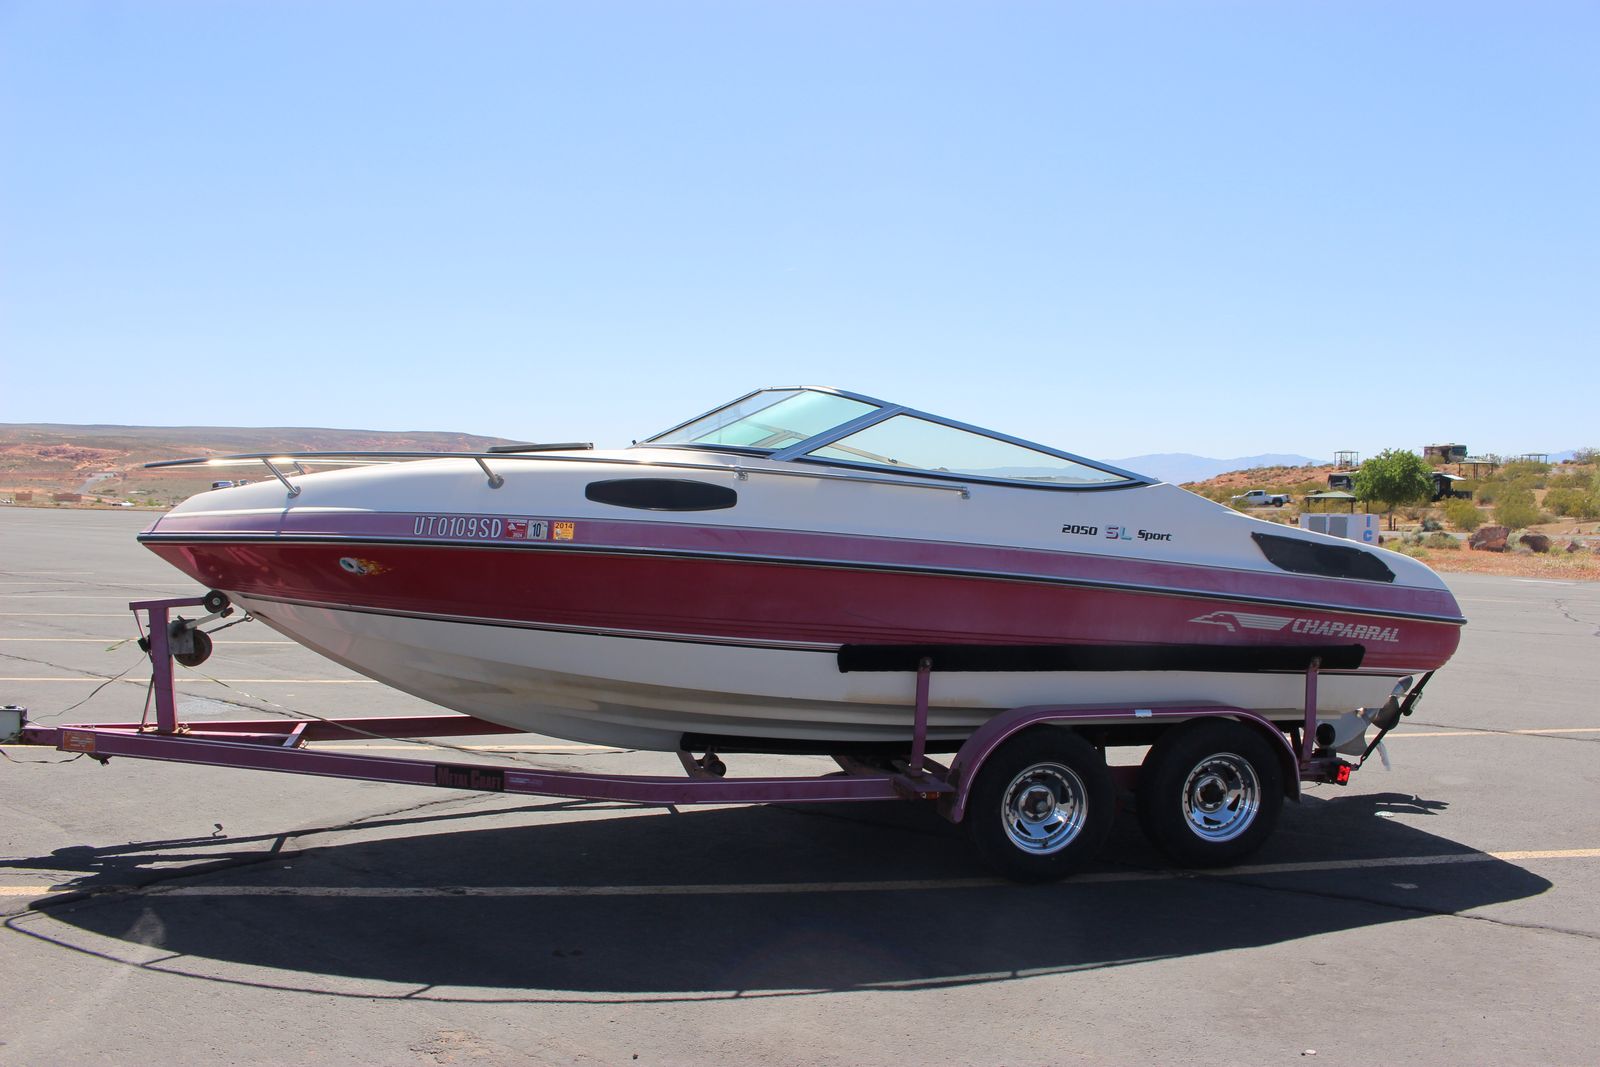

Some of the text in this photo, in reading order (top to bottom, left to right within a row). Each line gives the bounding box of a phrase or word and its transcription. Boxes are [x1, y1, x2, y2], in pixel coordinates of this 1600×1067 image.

[413, 516, 502, 538] UT0109SD
[533, 523, 542, 537] 10
[1061, 524, 1172, 541] 2050 SL Sport
[1291, 619, 1399, 642] CHAPARRAL
